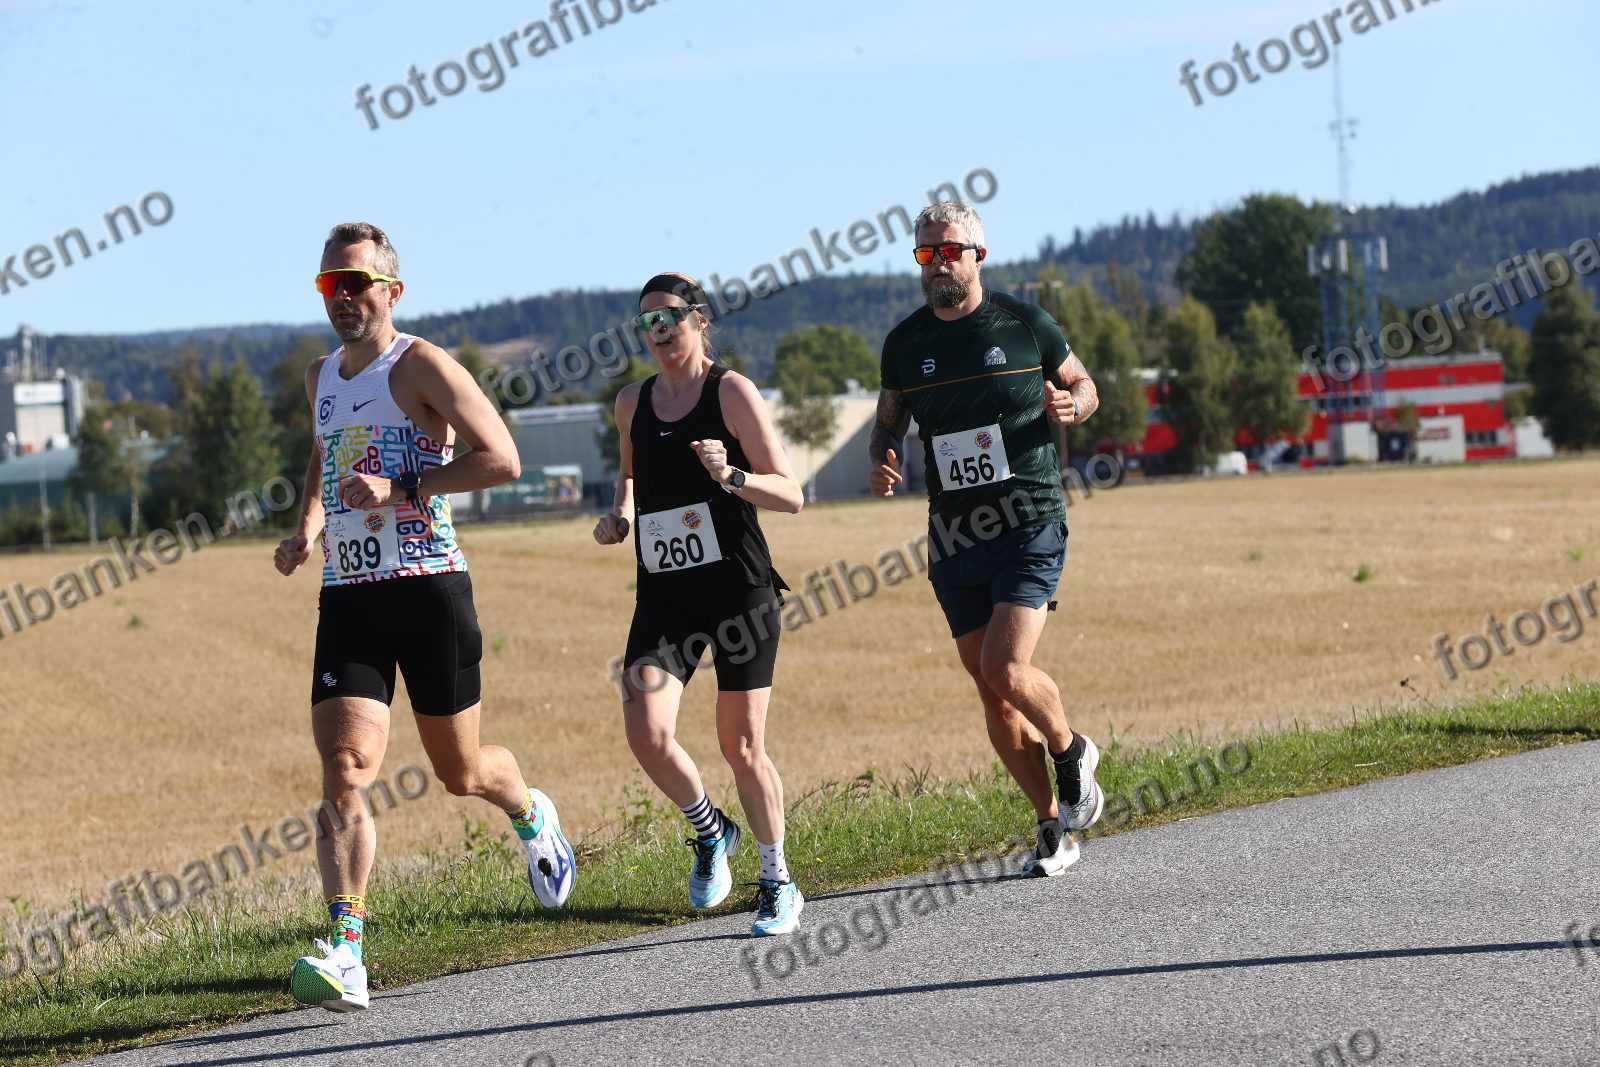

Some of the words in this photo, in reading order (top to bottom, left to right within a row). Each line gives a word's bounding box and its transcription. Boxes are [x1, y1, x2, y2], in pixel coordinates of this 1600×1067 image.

[949, 453, 995, 486] 456
[337, 535, 382, 573] 839
[653, 532, 705, 570] 260
